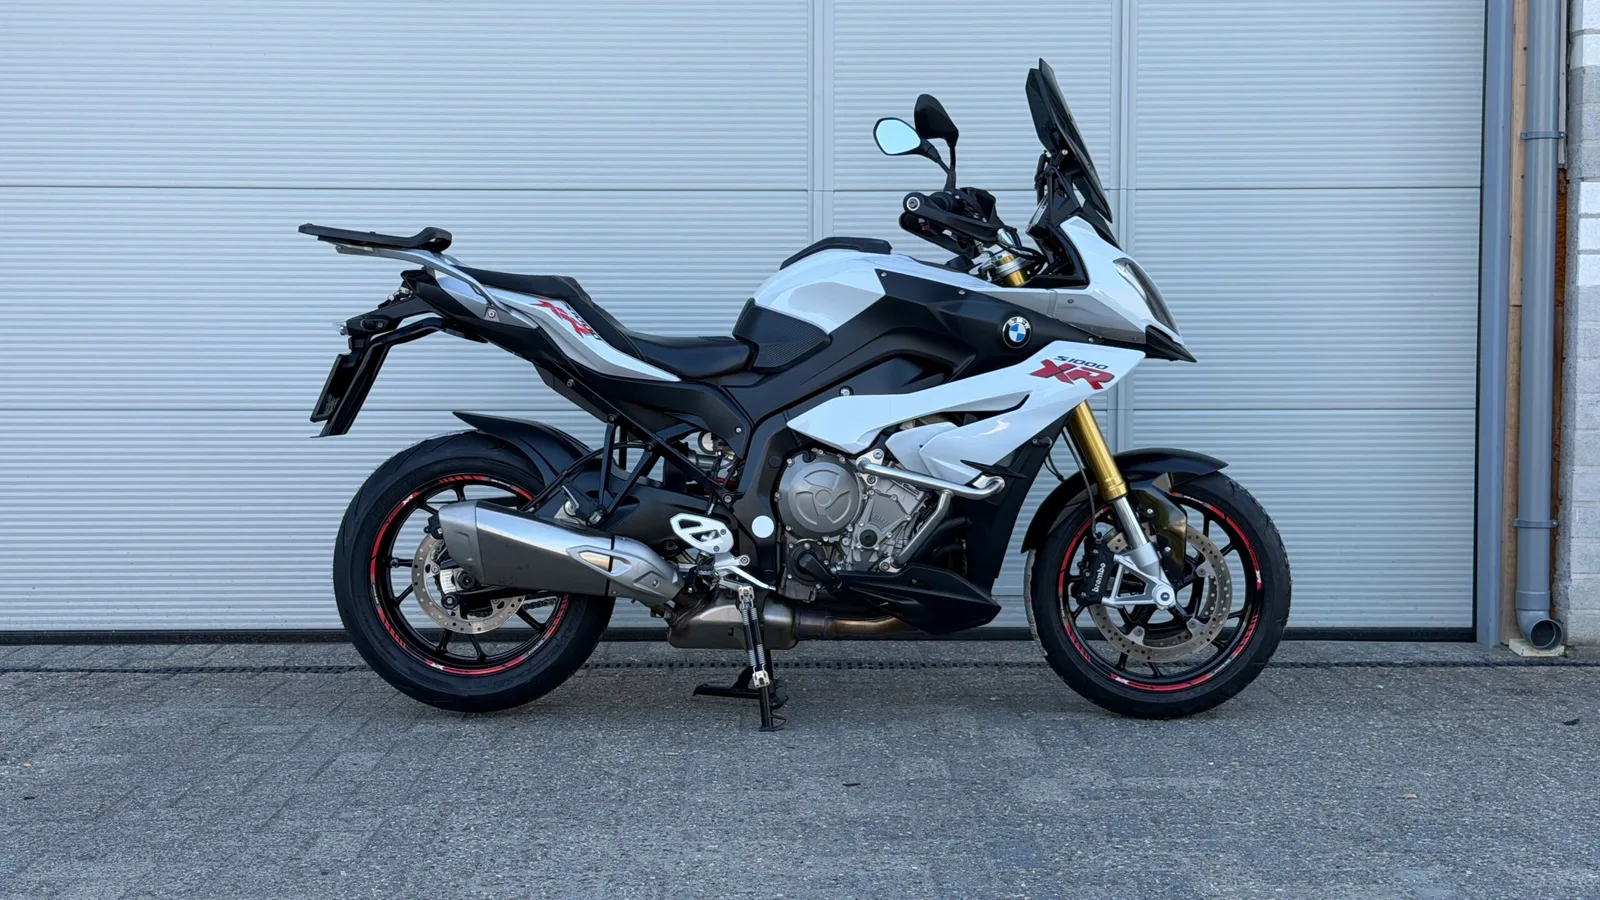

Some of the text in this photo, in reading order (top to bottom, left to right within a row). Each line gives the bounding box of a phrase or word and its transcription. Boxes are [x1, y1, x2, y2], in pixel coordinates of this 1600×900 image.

[1028, 359, 1115, 390] XR
[1053, 355, 1109, 370] S1000
[1091, 562, 1106, 593] brembo
